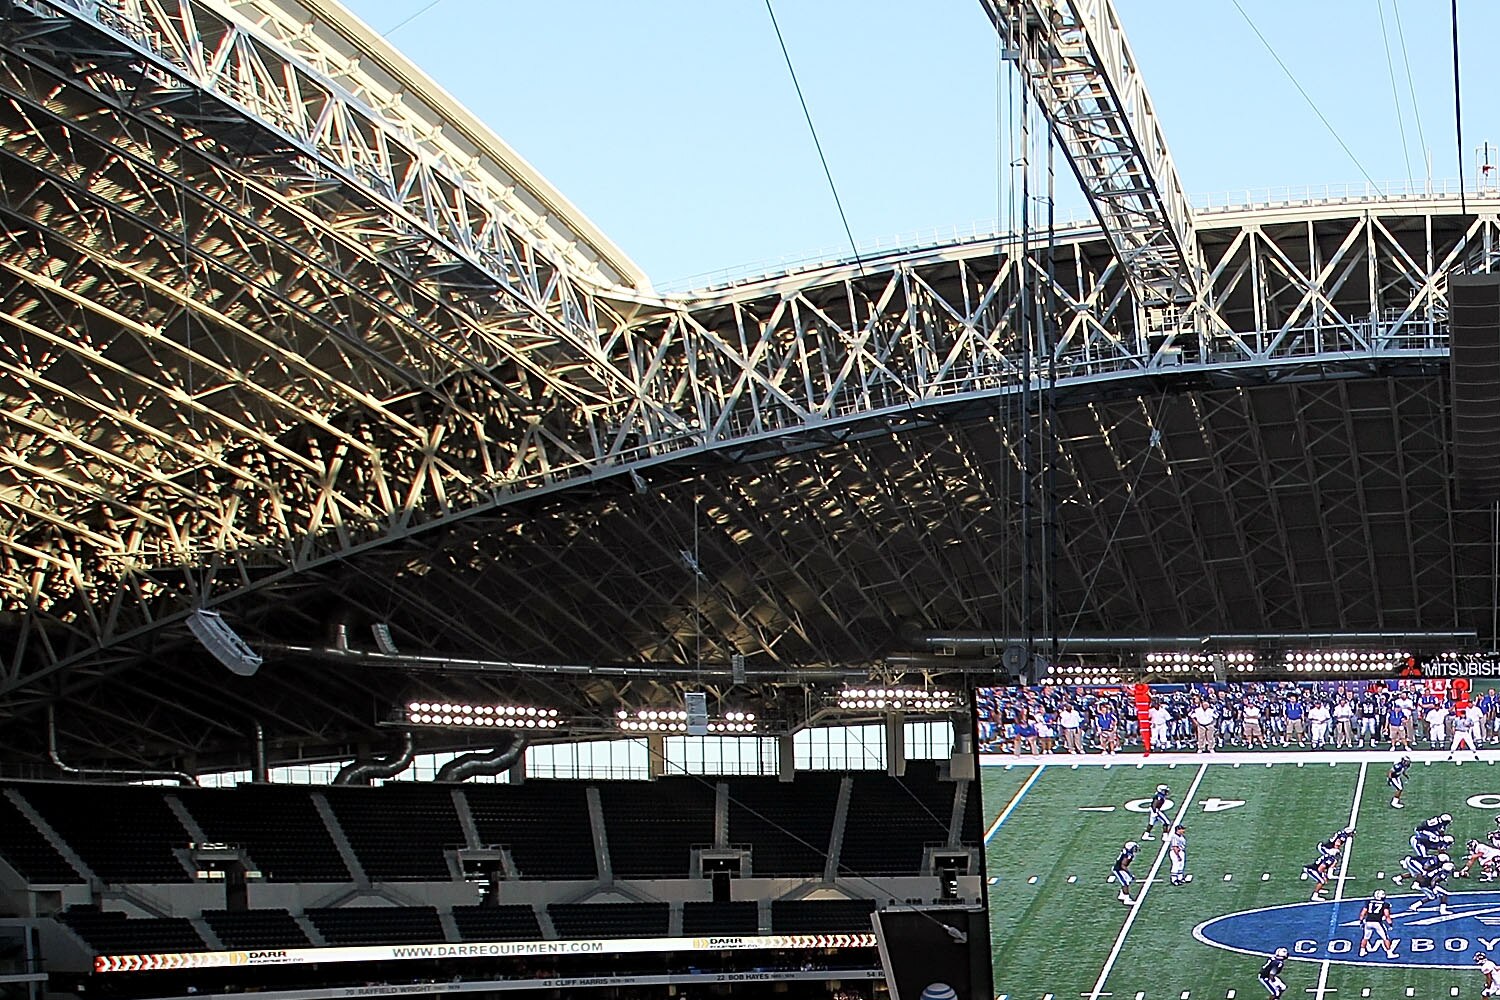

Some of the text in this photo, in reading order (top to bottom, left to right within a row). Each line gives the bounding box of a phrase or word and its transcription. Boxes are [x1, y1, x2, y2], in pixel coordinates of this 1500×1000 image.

[1368, 901, 1383, 914] 17
[392, 942, 603, 958] WWW.DARREQUIPMENT.COM
[249, 951, 287, 959] DARR
[746, 973, 769, 981] HAYES
[555, 979, 576, 987] CLIFF
